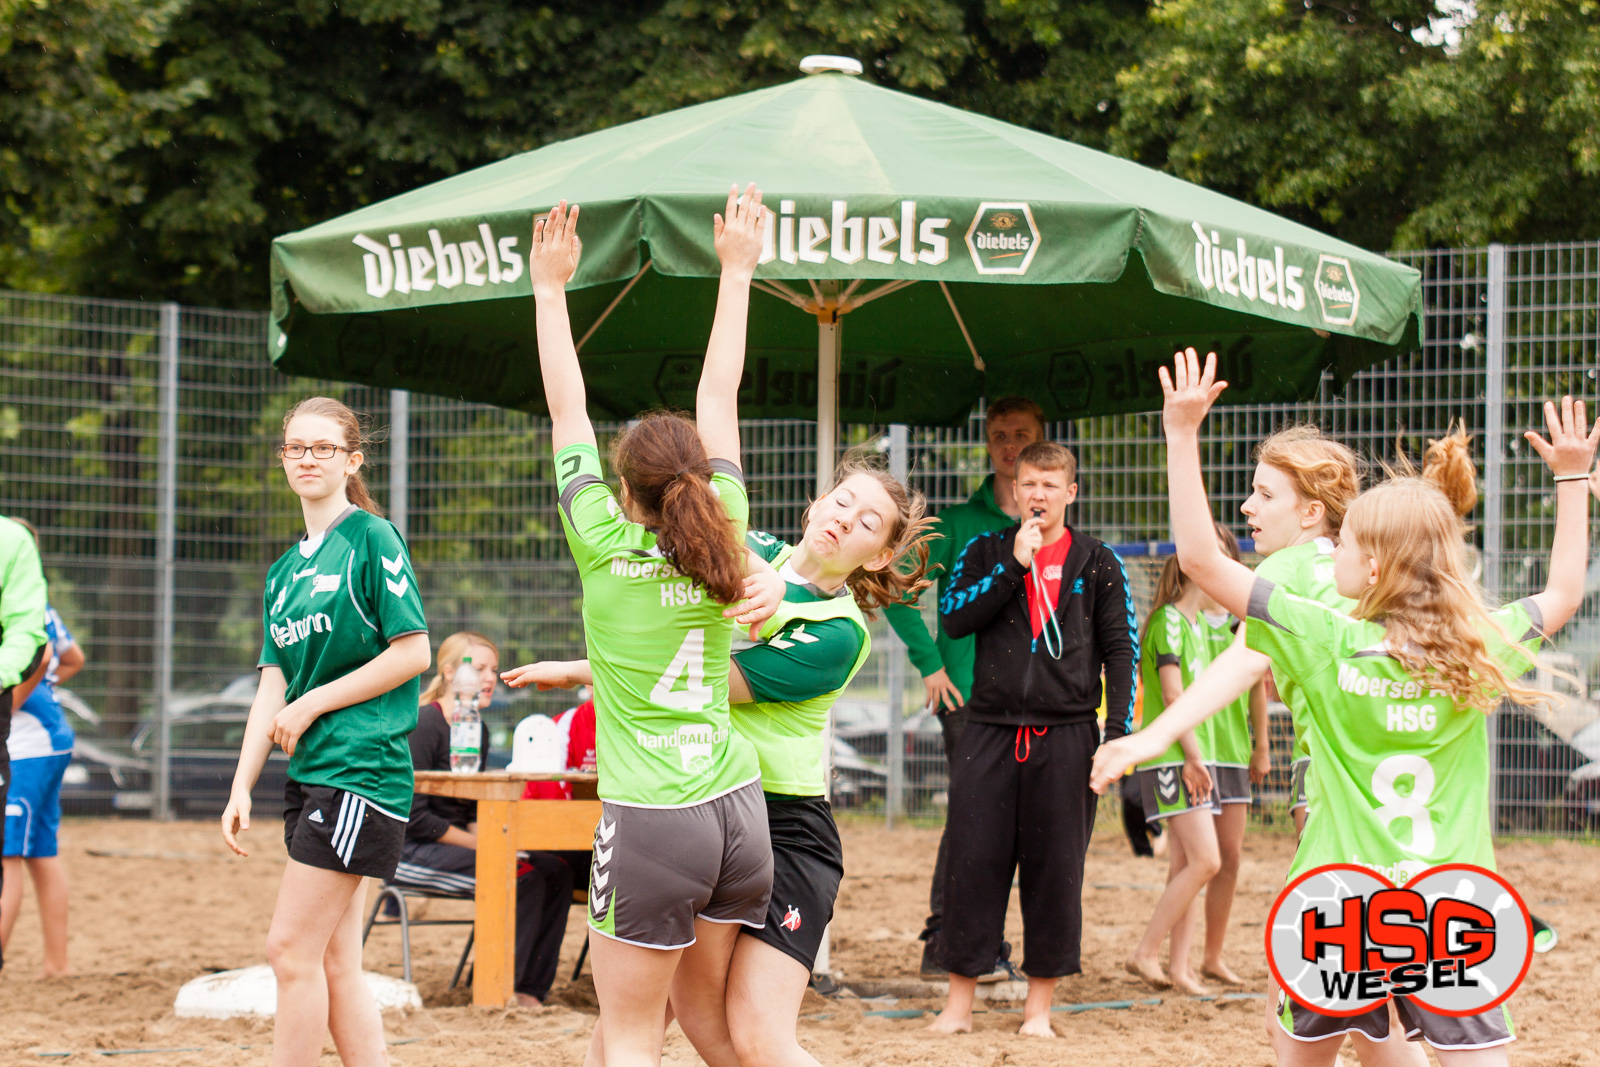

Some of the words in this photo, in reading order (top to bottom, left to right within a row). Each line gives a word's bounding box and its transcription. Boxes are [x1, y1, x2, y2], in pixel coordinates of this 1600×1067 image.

[352, 223, 524, 298] Diebels
[976, 231, 1030, 250] Diebels
[1191, 220, 1305, 312] Diebels
[660, 582, 702, 607] HSG
[650, 628, 713, 711] 4
[1386, 704, 1437, 732] HSG
[1371, 754, 1436, 857] 8
